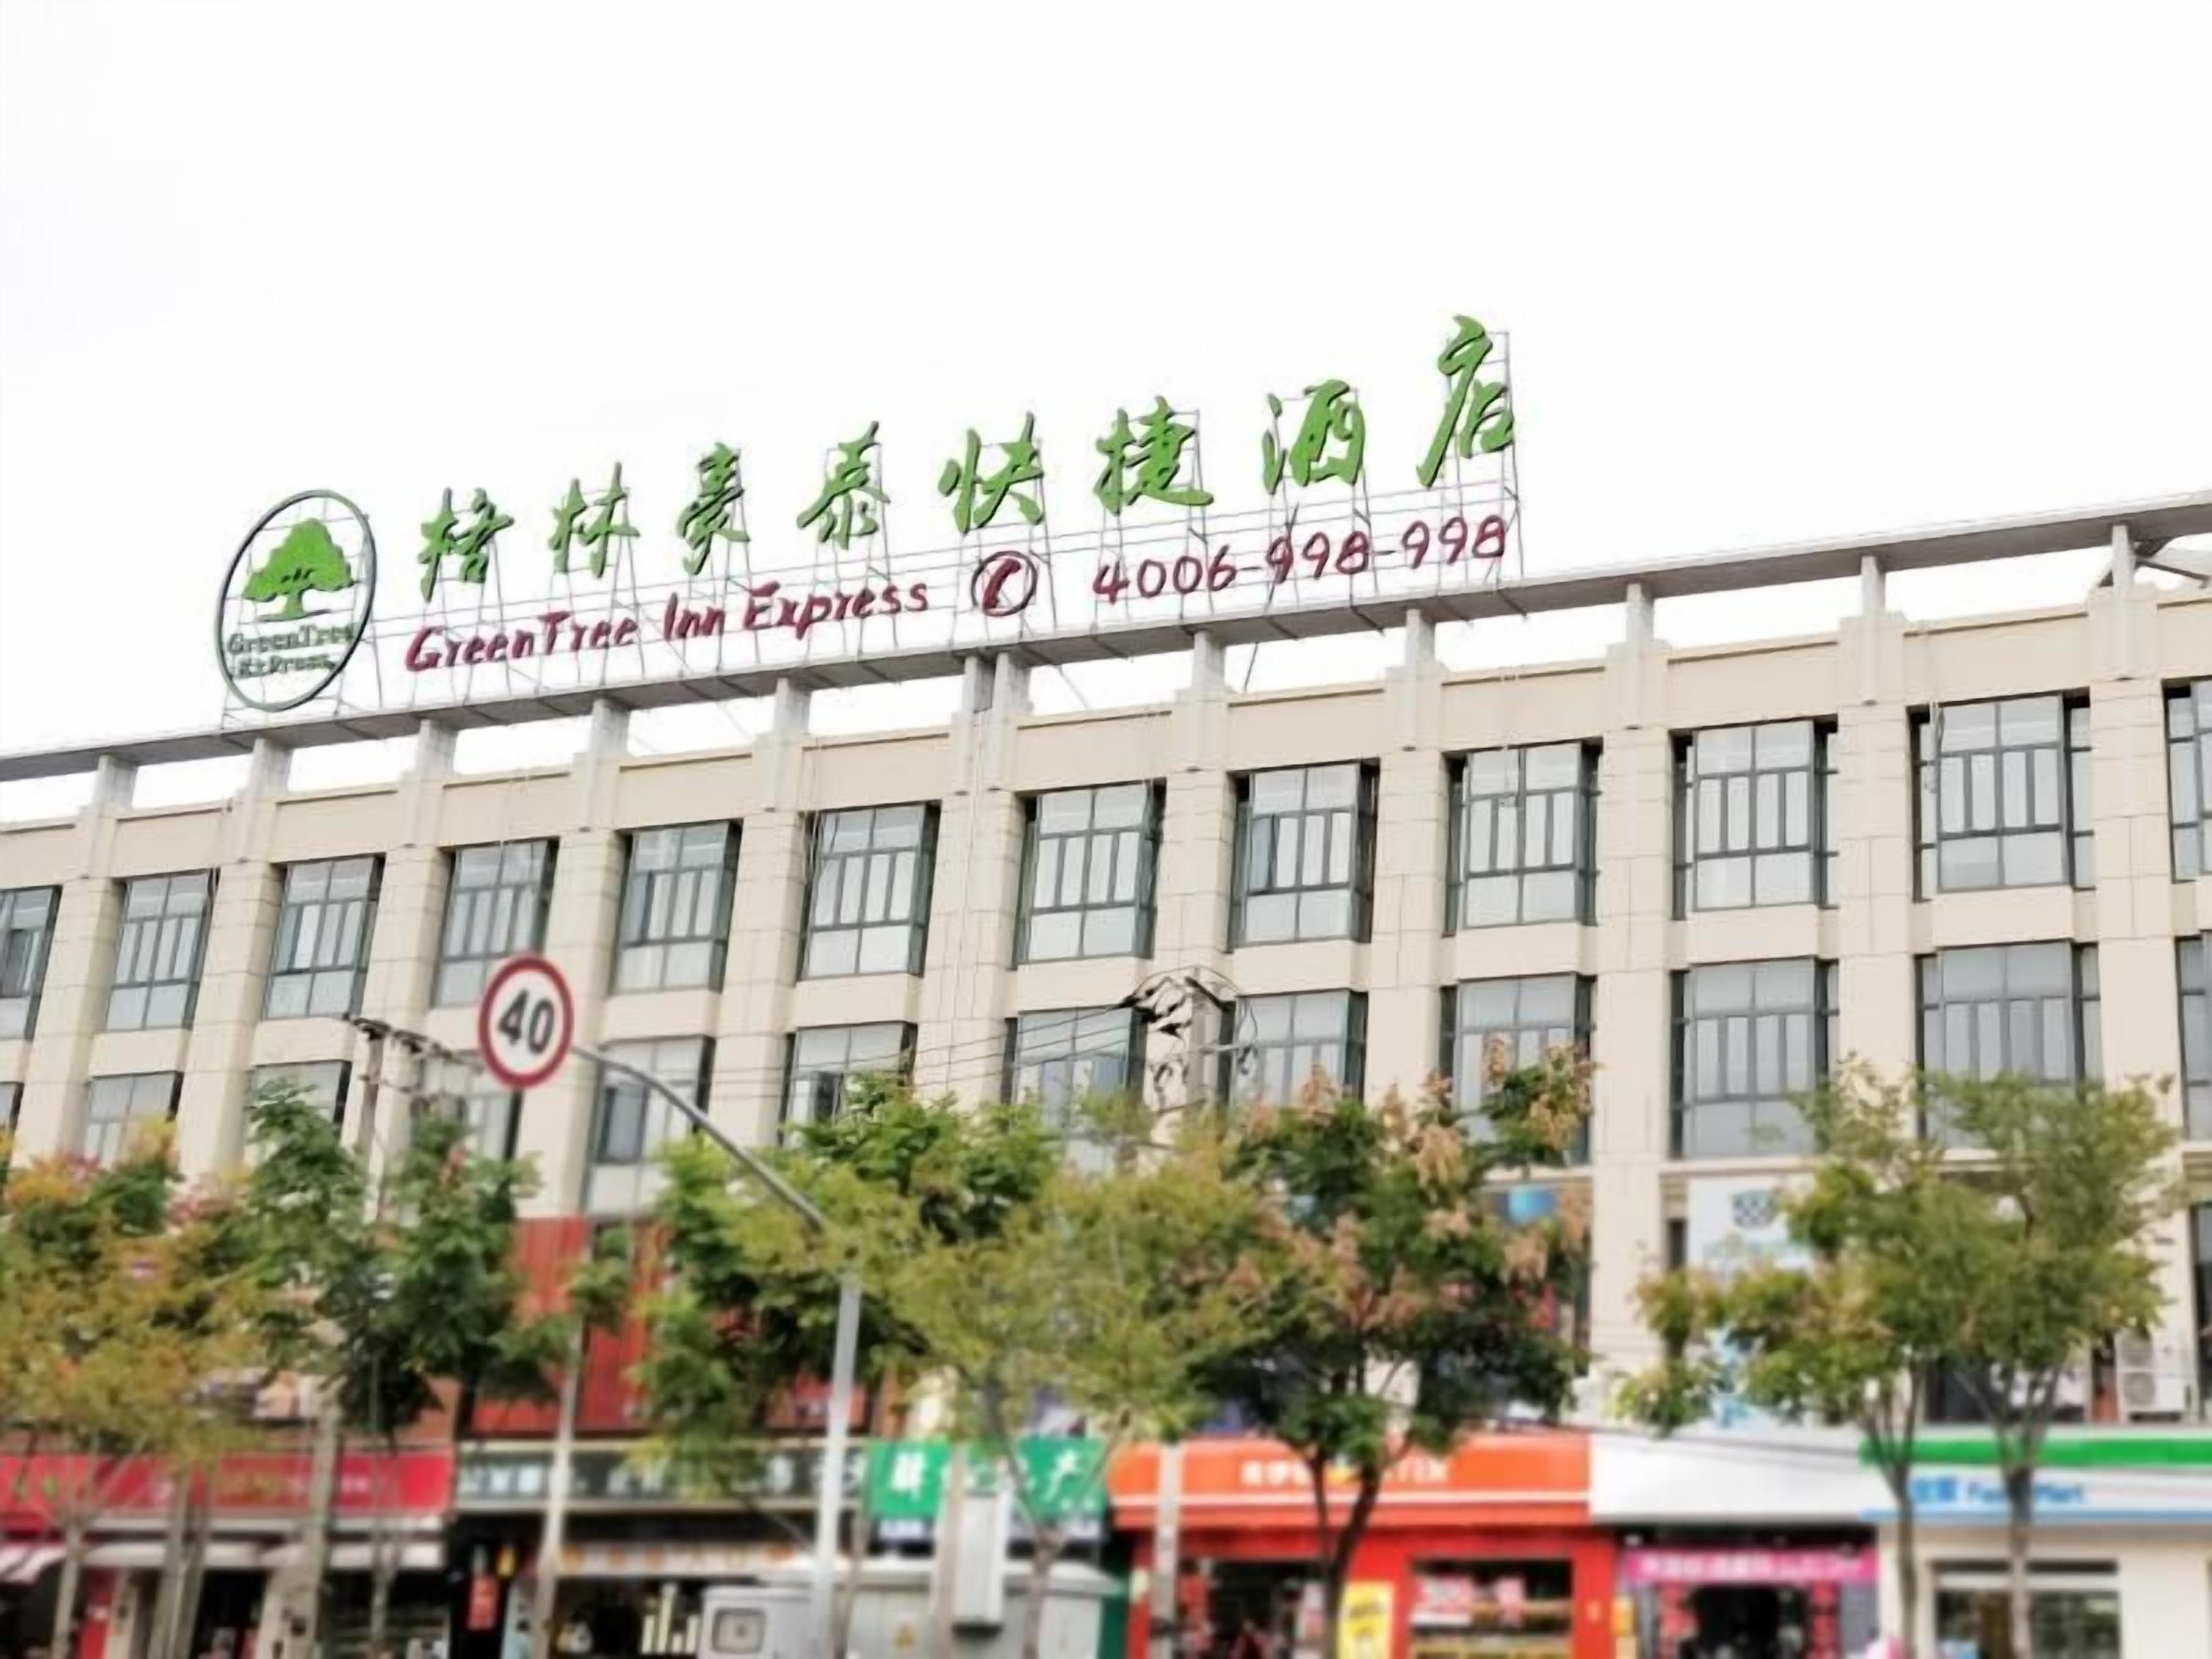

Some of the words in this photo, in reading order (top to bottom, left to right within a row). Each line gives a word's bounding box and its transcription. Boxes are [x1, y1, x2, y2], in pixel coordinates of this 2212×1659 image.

[415, 315, 1514, 602] 格林豪泰快捷酒店
[406, 611, 637, 672] GreenTree
[664, 592, 726, 640] Inn
[744, 581, 928, 639] Express
[1093, 514, 1506, 604] 4006-998-998
[498, 989, 555, 1056] 40
